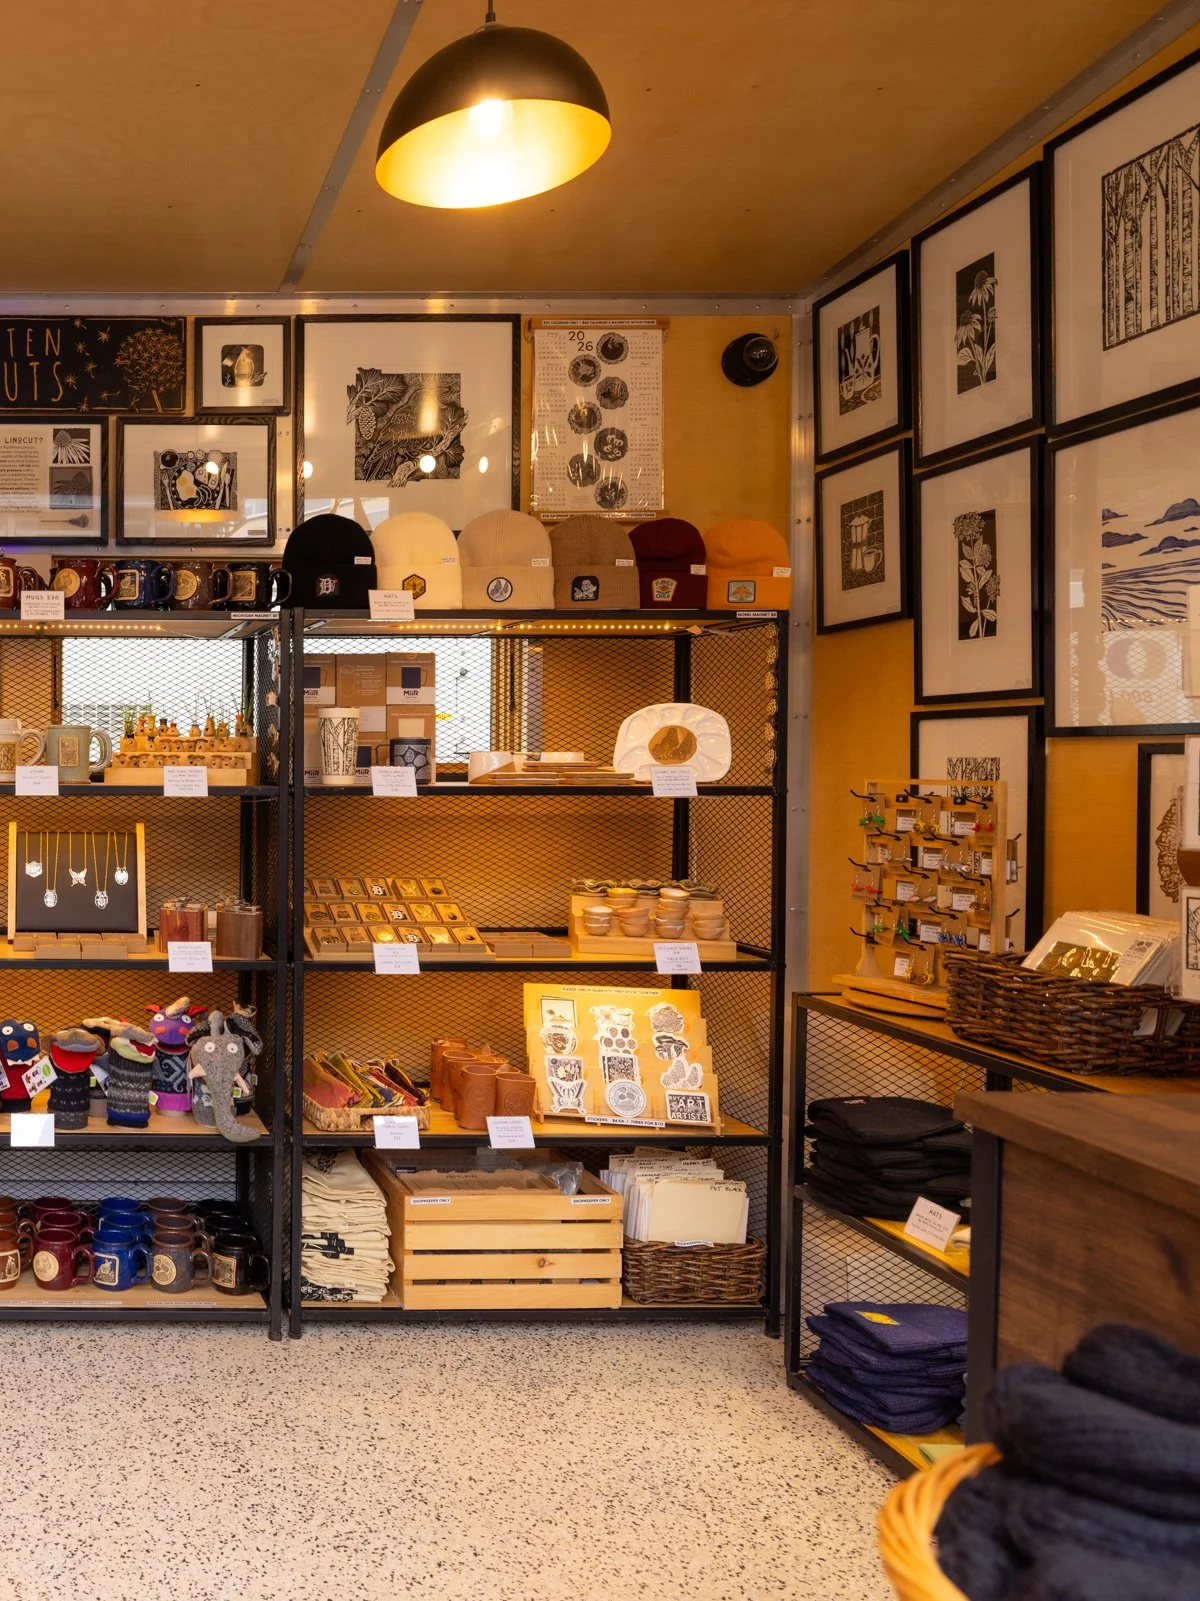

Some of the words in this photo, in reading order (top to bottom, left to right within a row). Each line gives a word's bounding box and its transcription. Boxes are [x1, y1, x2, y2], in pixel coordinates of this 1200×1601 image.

[568, 331, 585, 341] 20
[578, 341, 594, 351] 26
[678, 1099, 705, 1108] ART
[671, 1112, 707, 1121] ARTISTS
